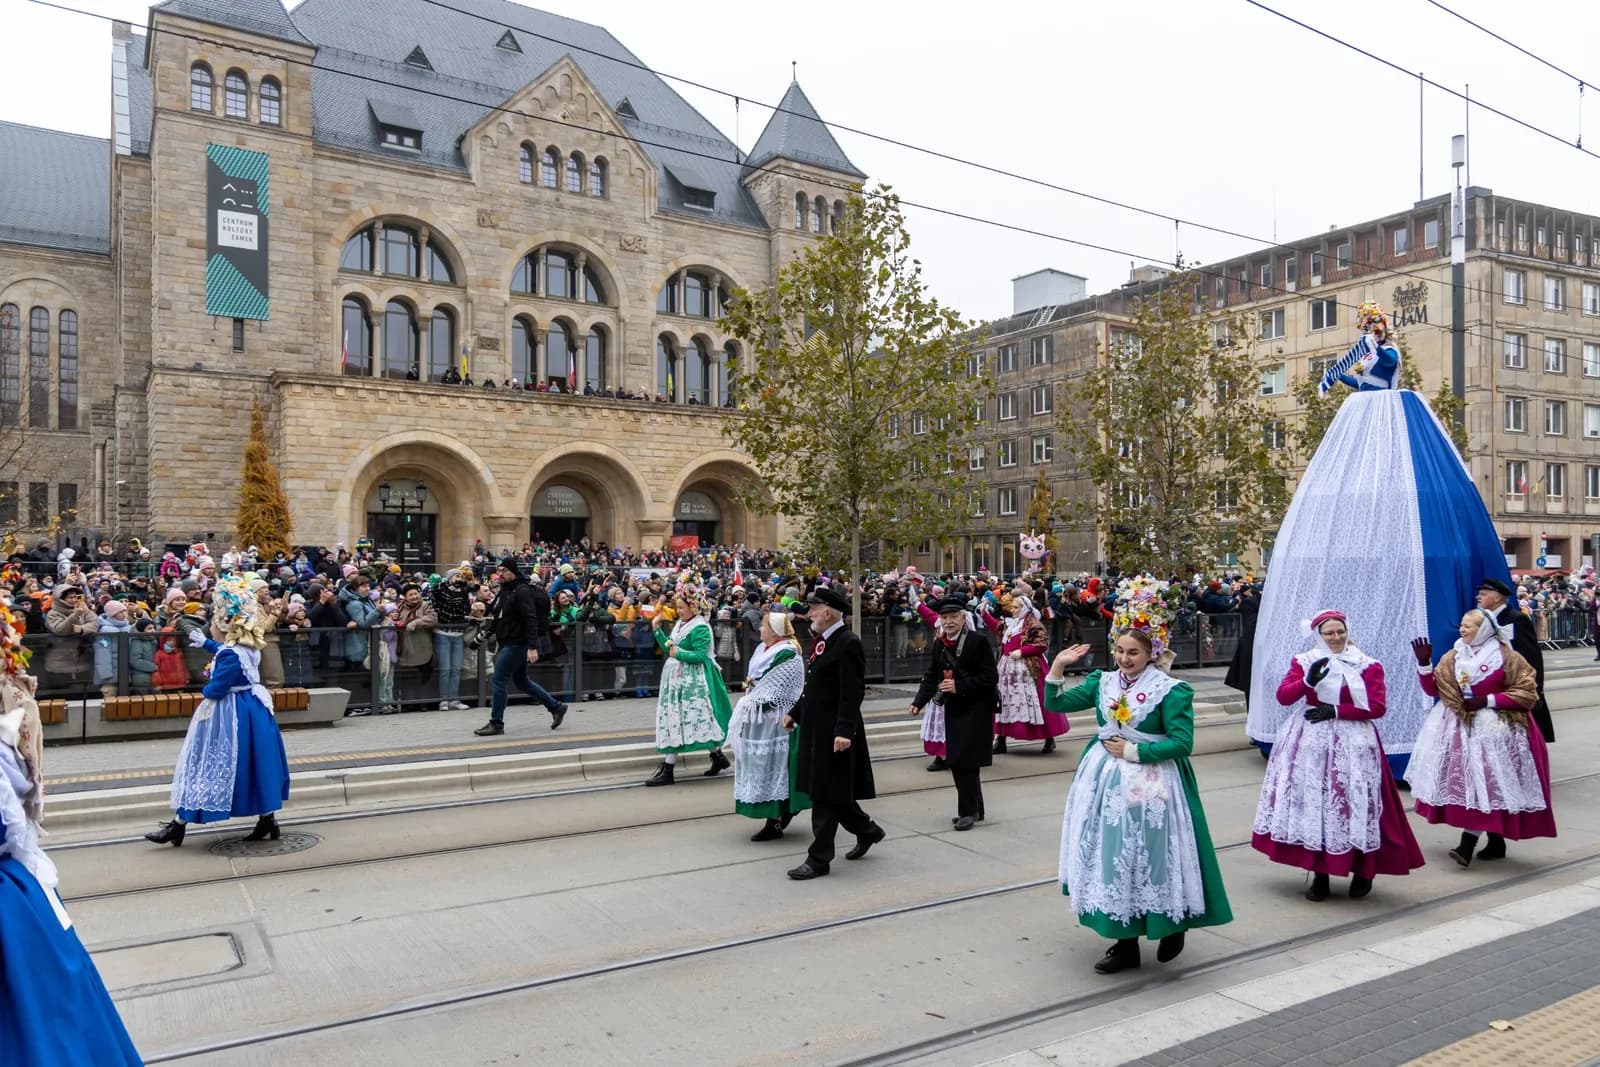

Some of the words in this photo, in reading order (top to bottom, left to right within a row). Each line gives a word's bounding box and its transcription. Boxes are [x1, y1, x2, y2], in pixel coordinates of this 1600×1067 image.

[222, 217, 253, 226] CENTRUM
[222, 226, 253, 234] KULTURY
[231, 234, 253, 242] ZAMEK
